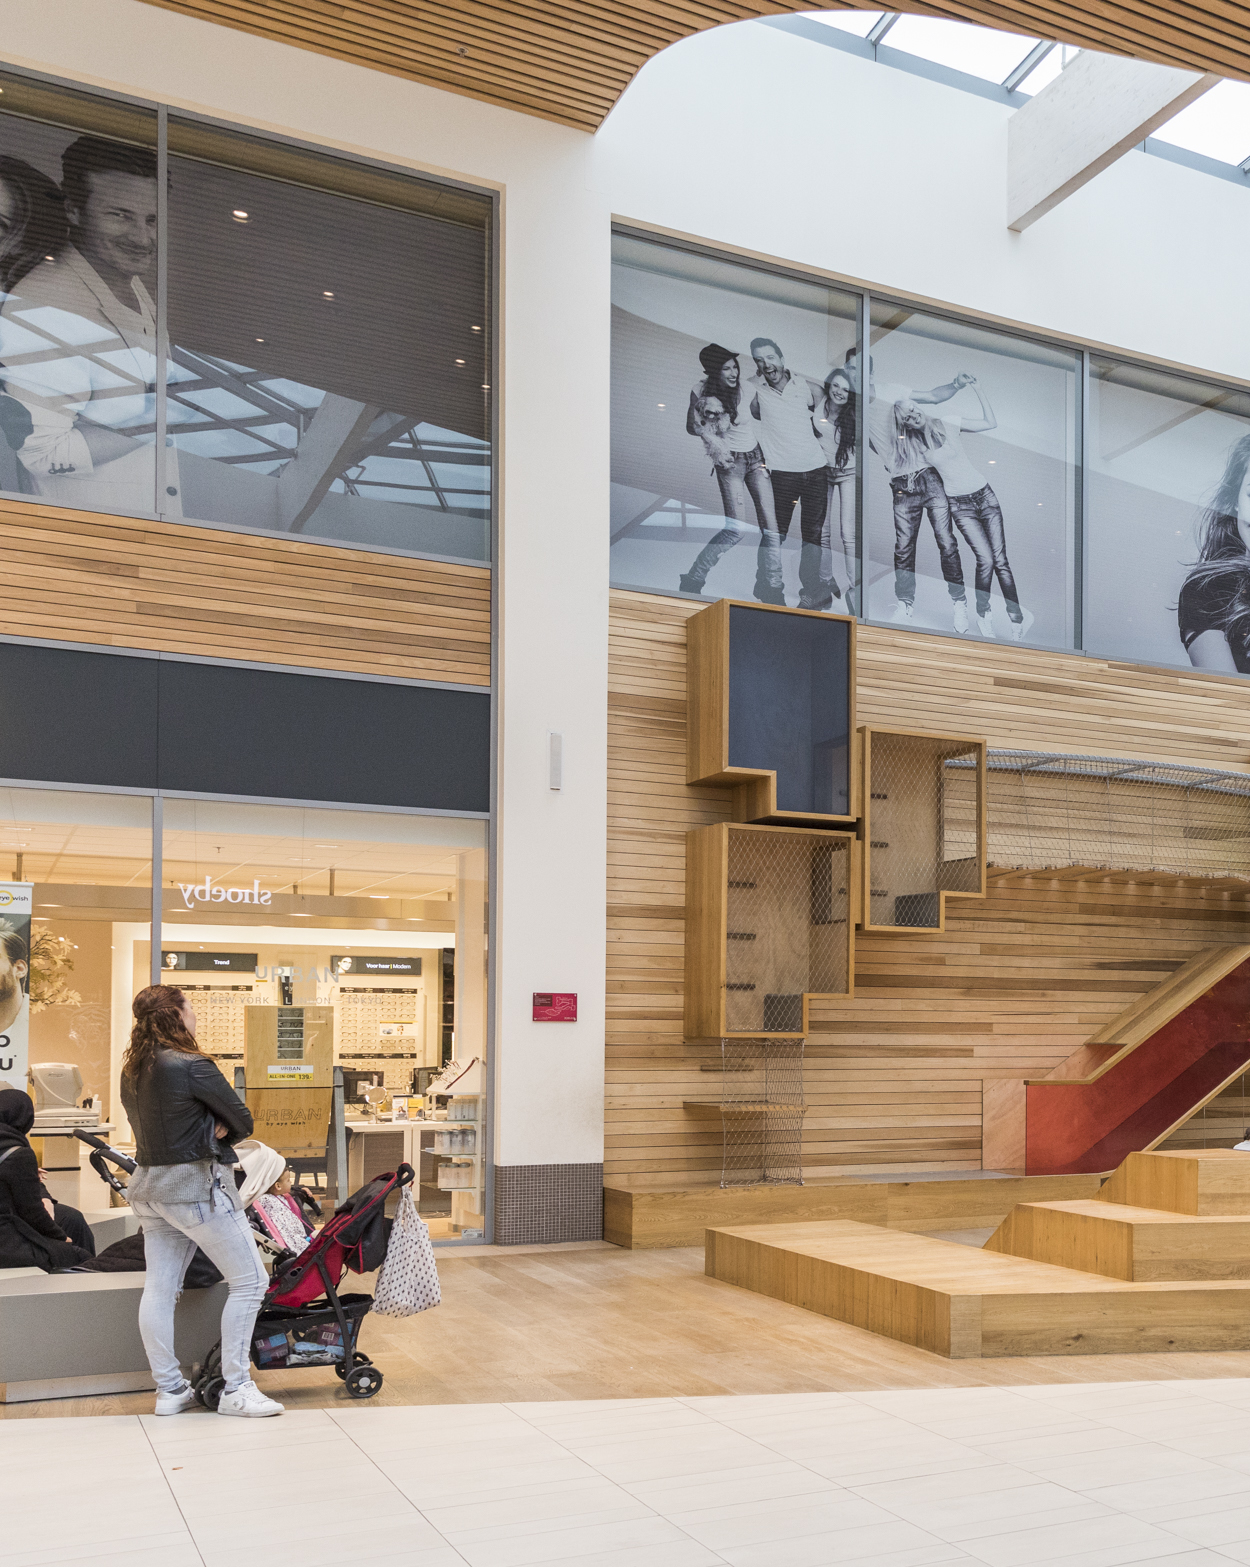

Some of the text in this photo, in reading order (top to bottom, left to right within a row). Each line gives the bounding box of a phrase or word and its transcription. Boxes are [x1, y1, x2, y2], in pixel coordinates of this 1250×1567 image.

[255, 966, 339, 982] URBAN
[210, 996, 236, 1005] NEW
[239, 996, 270, 1005] YORK
[285, 996, 331, 1006] LONDON
[346, 996, 383, 1006] TOKYO
[253, 1108, 322, 1121] URBAN
